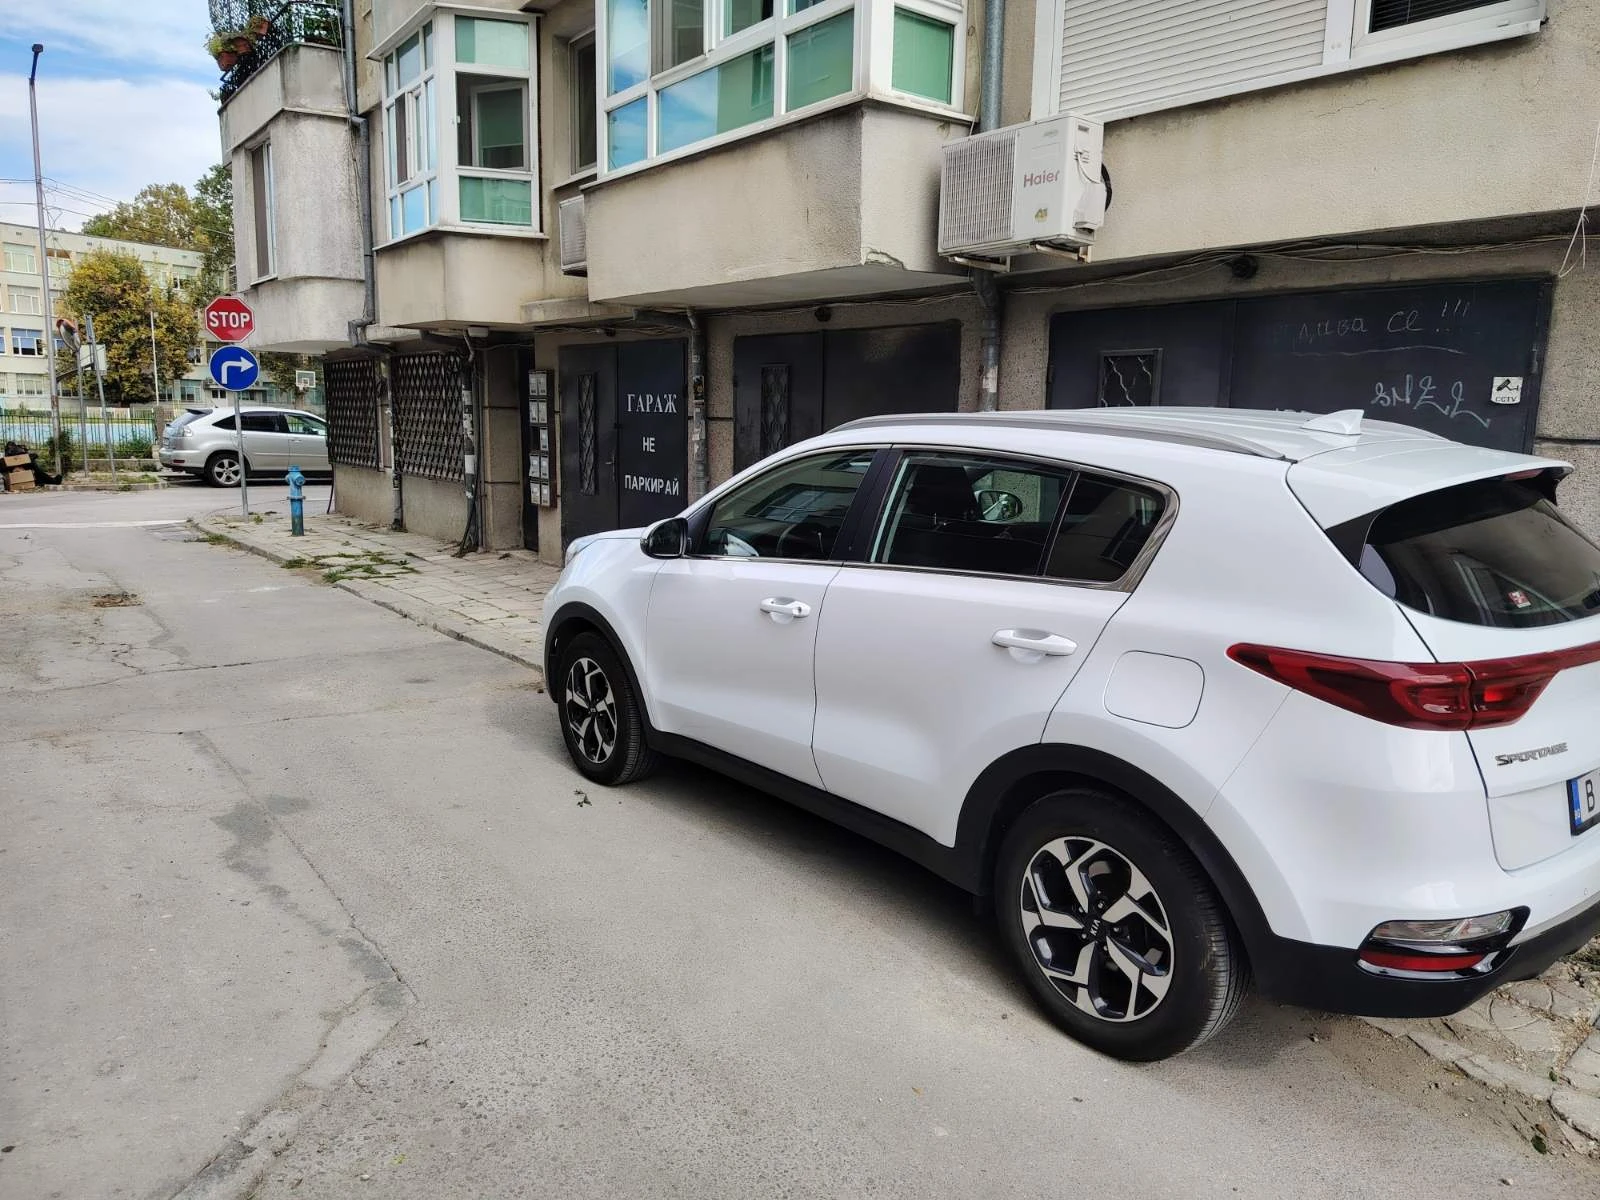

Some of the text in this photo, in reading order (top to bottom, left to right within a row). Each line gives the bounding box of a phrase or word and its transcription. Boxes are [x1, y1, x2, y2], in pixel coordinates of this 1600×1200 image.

[1023, 169, 1060, 188] Haier
[209, 311, 250, 328] STOP
[627, 393, 677, 413] ГАРАЖ
[642, 436, 656, 453] НЕ
[624, 474, 679, 496] ПАРКИРАЙ
[1495, 742, 1568, 766] SPORTAGE
